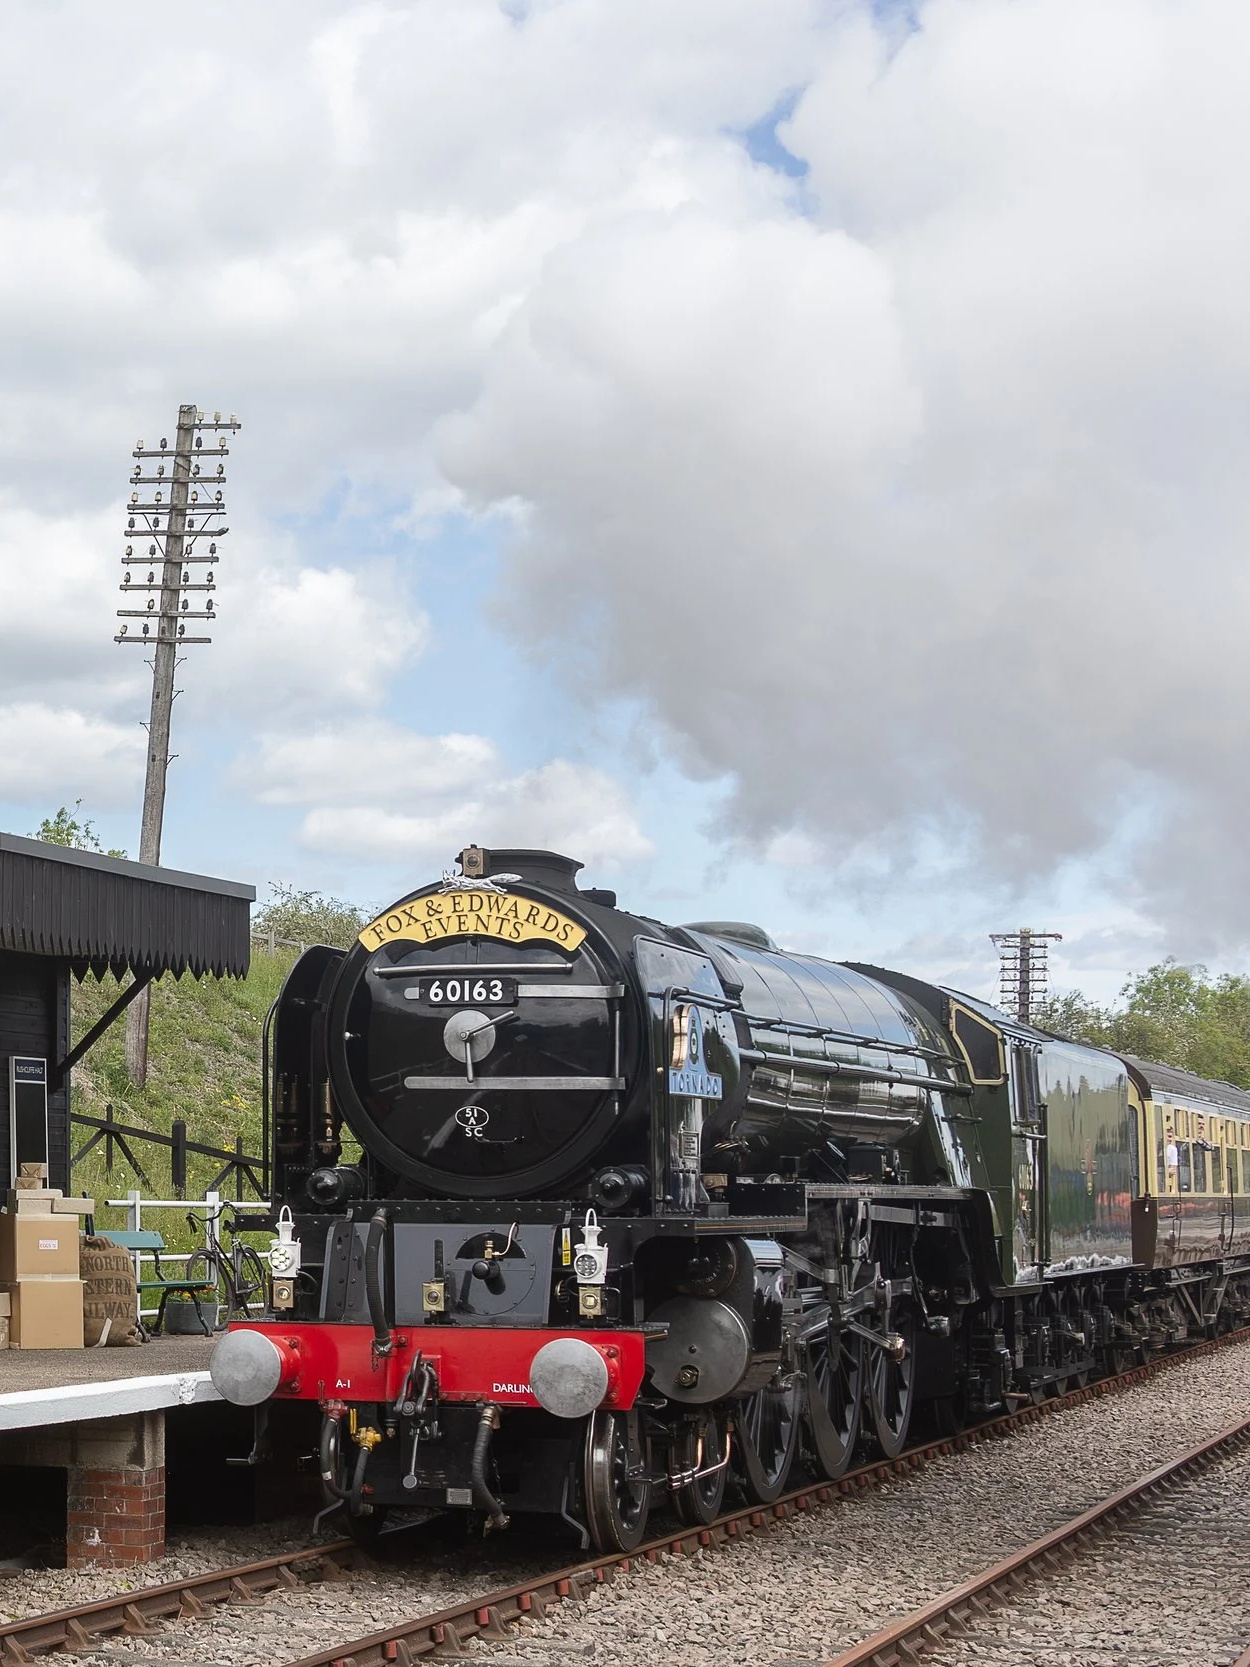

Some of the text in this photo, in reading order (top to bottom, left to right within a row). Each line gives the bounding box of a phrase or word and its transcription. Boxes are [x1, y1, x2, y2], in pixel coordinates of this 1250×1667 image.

[370, 894, 575, 943] FOX & EDWARDS
[420, 913, 524, 940] EVENTS
[429, 980, 503, 1002] 60163
[672, 1071, 718, 1095] TORNADO
[465, 1108, 478, 1118] 51
[468, 1116, 477, 1125] A
[465, 1127, 483, 1137] SC
[84, 1255, 129, 1272] NORTH
[85, 1278, 132, 1296] STERN
[493, 1383, 533, 1394] DARLIN
